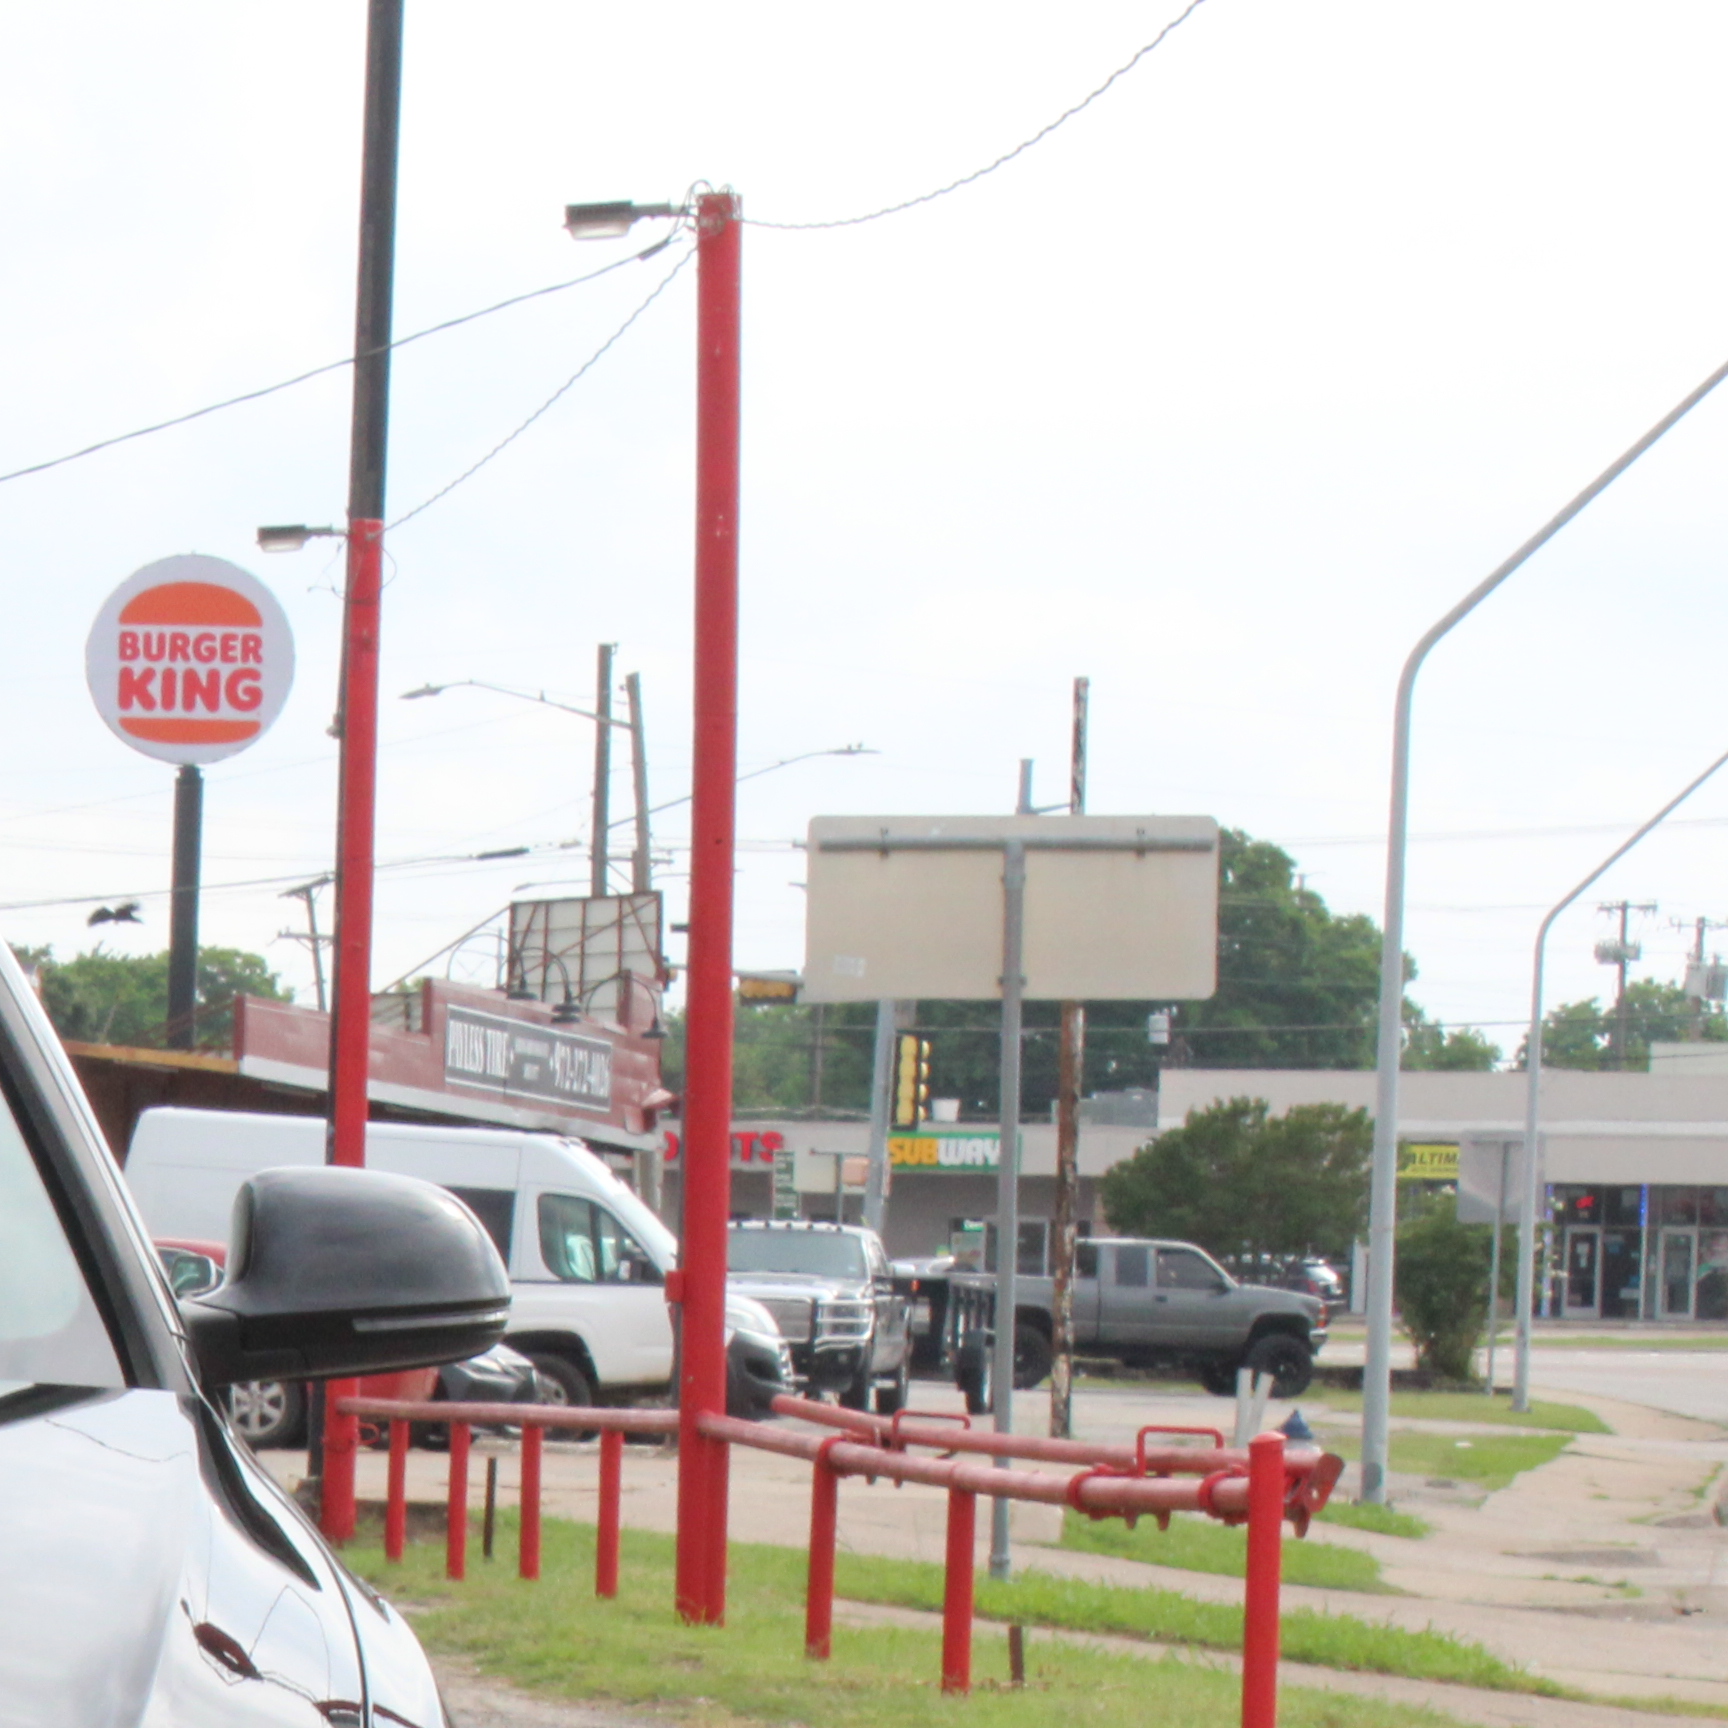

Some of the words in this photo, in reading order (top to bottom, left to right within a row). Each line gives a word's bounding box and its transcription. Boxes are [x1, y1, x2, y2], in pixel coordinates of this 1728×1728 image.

[119, 631, 263, 664] BURGER
[117, 667, 264, 713] KING
[888, 1137, 1001, 1166] SUBWAY
